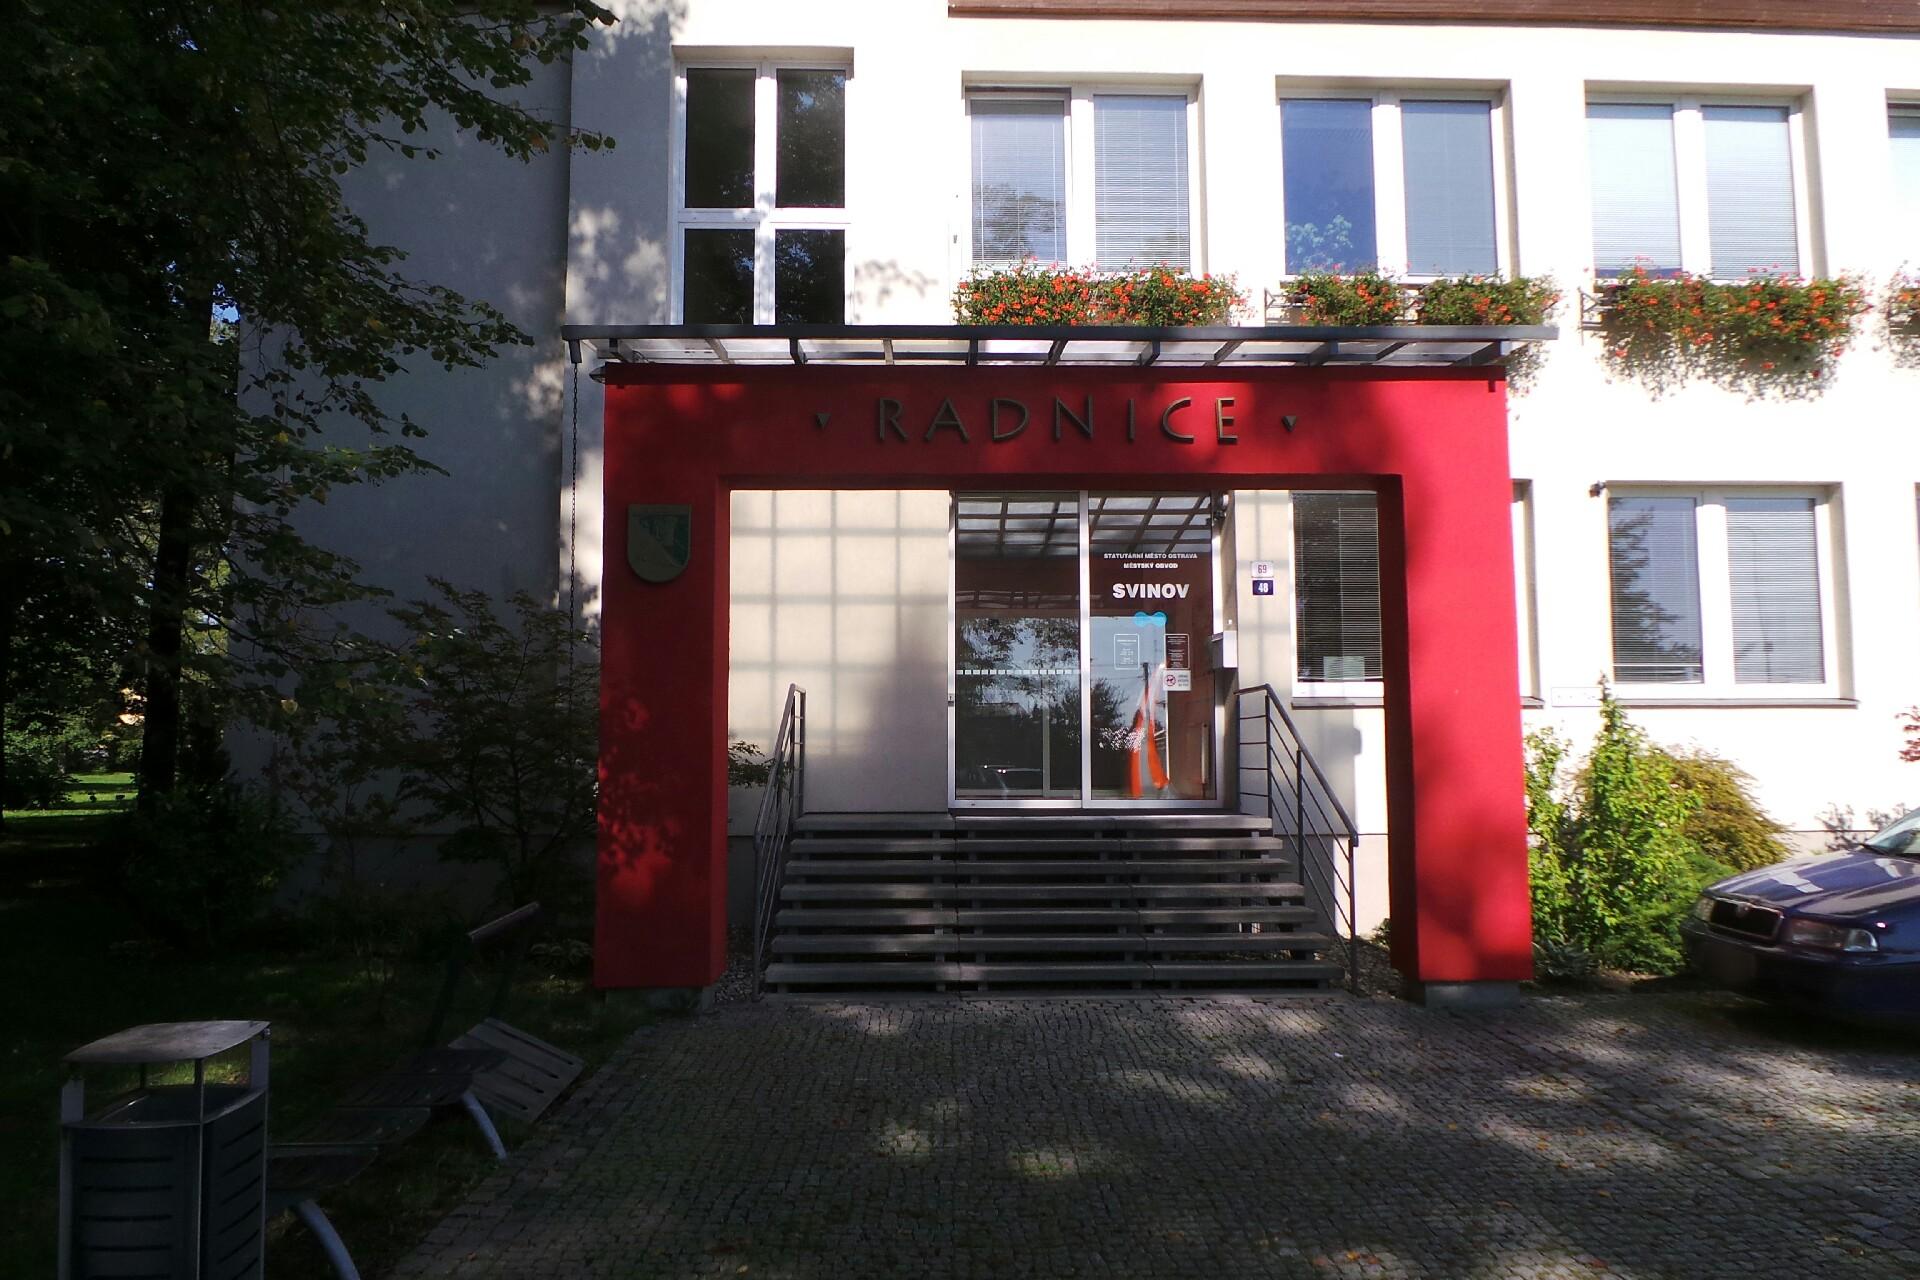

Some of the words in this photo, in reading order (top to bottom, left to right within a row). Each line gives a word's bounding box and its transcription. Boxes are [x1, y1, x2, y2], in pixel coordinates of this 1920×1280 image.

[878, 396, 1239, 443] RADNICE
[1257, 564, 1267, 574] 69
[1112, 583, 1190, 599] SVINOV
[1258, 582, 1269, 593] 48
